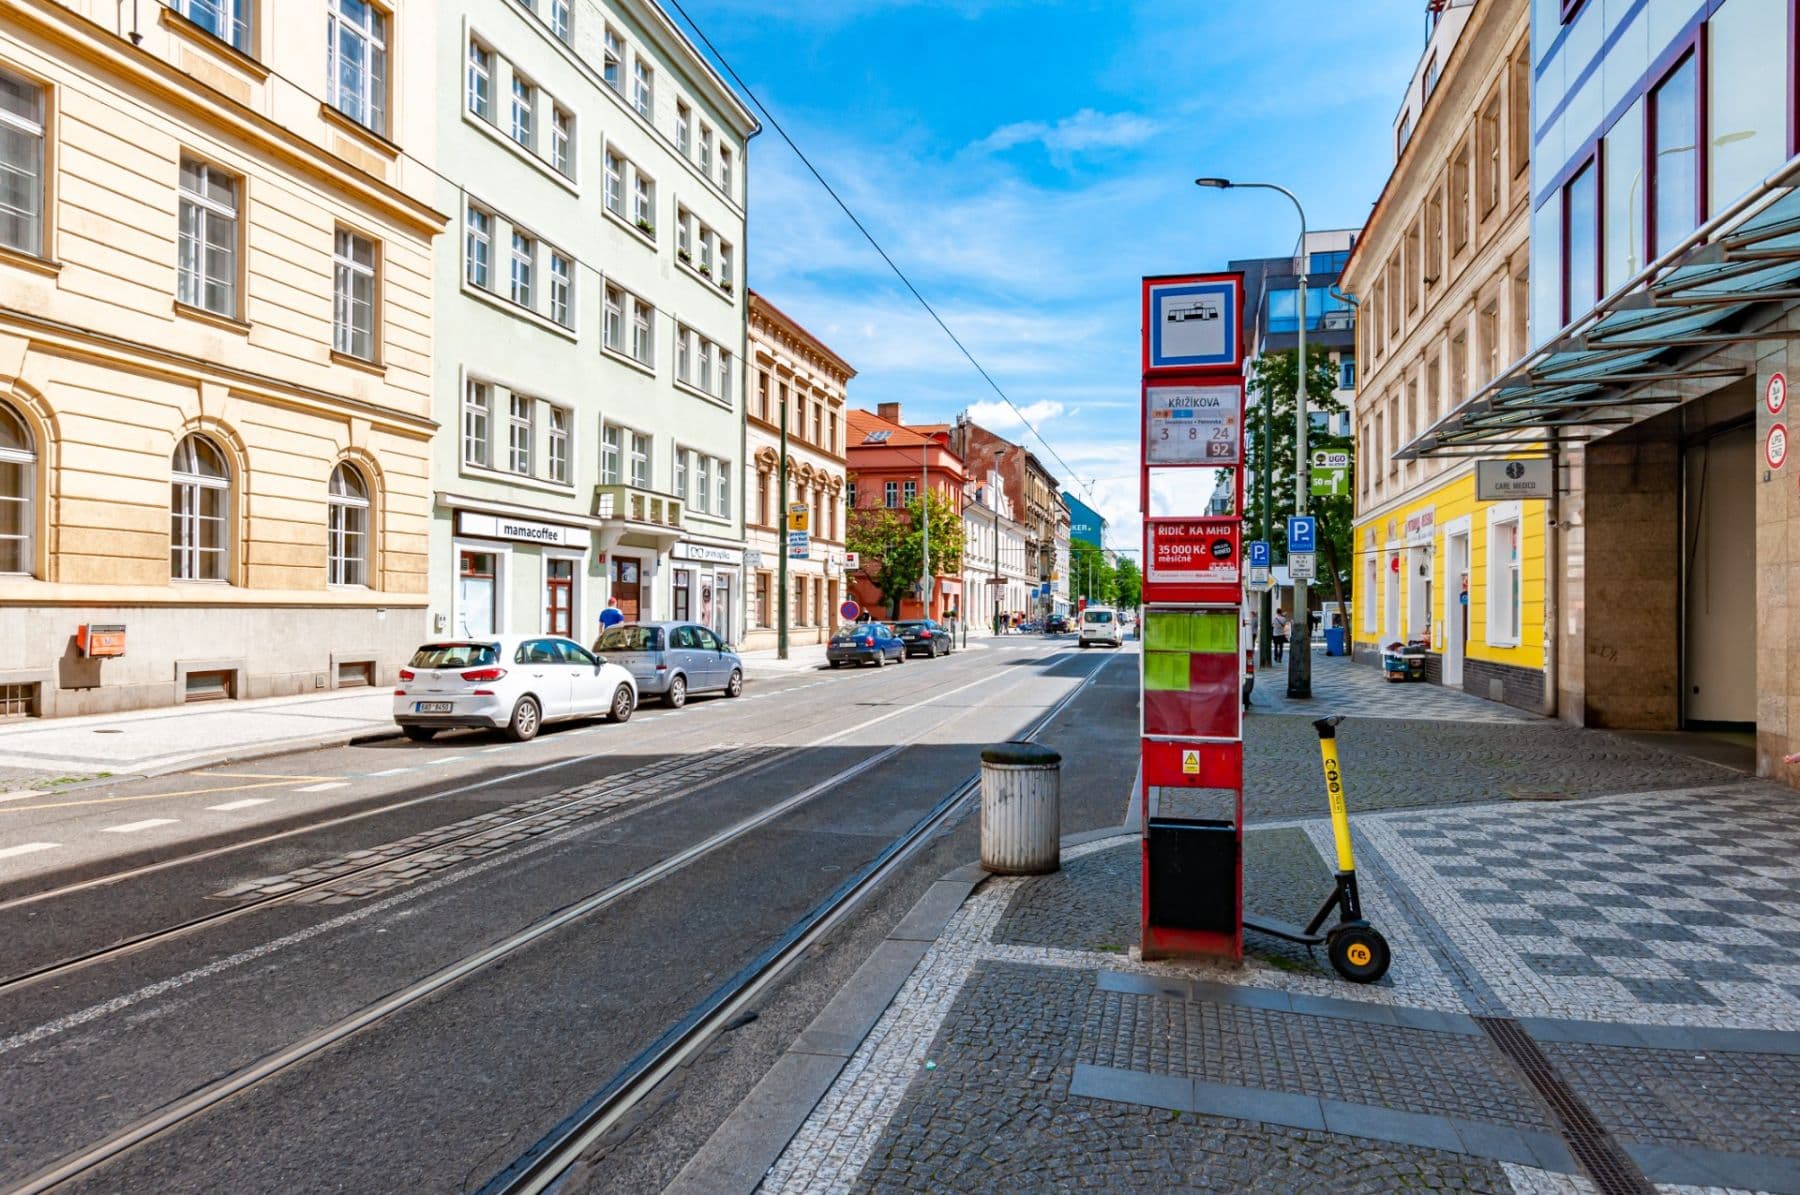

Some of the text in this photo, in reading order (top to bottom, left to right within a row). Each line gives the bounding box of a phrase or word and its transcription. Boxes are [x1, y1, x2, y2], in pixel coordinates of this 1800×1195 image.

[1168, 396, 1220, 408] KŘIŽÍKOVA
[1160, 427, 1230, 440] 3 8 24
[1212, 443, 1229, 456] 92
[1328, 455, 1346, 463] UGO
[504, 524, 558, 541] mamacoffee
[1188, 526, 1204, 536] KA
[1206, 526, 1231, 536] MHD
[1294, 521, 1310, 542] P
[1254, 544, 1265, 560] P
